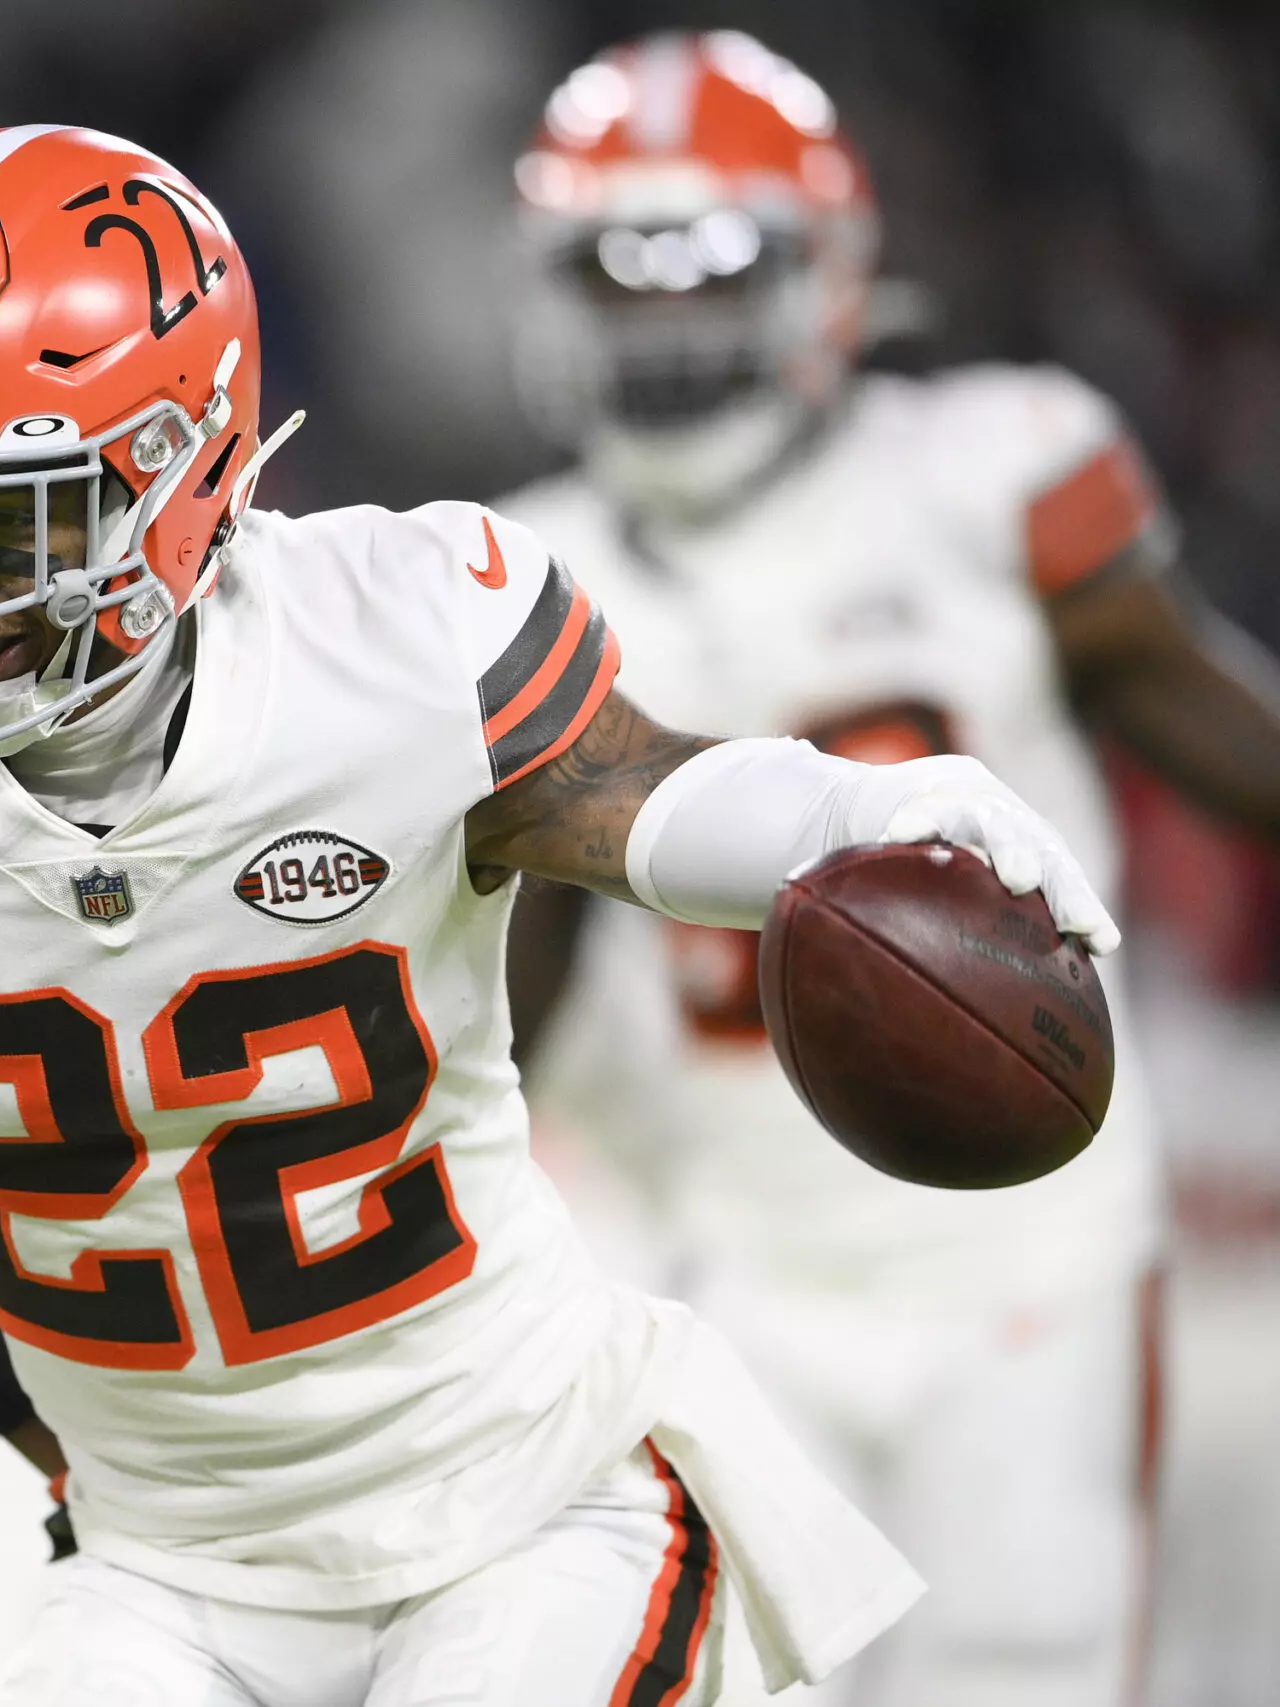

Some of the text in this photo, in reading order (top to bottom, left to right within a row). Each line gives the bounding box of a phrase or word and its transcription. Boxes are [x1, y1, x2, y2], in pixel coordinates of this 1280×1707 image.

[84, 179, 228, 341] 22
[263, 852, 360, 905] 1946
[86, 893, 126, 918] NFL
